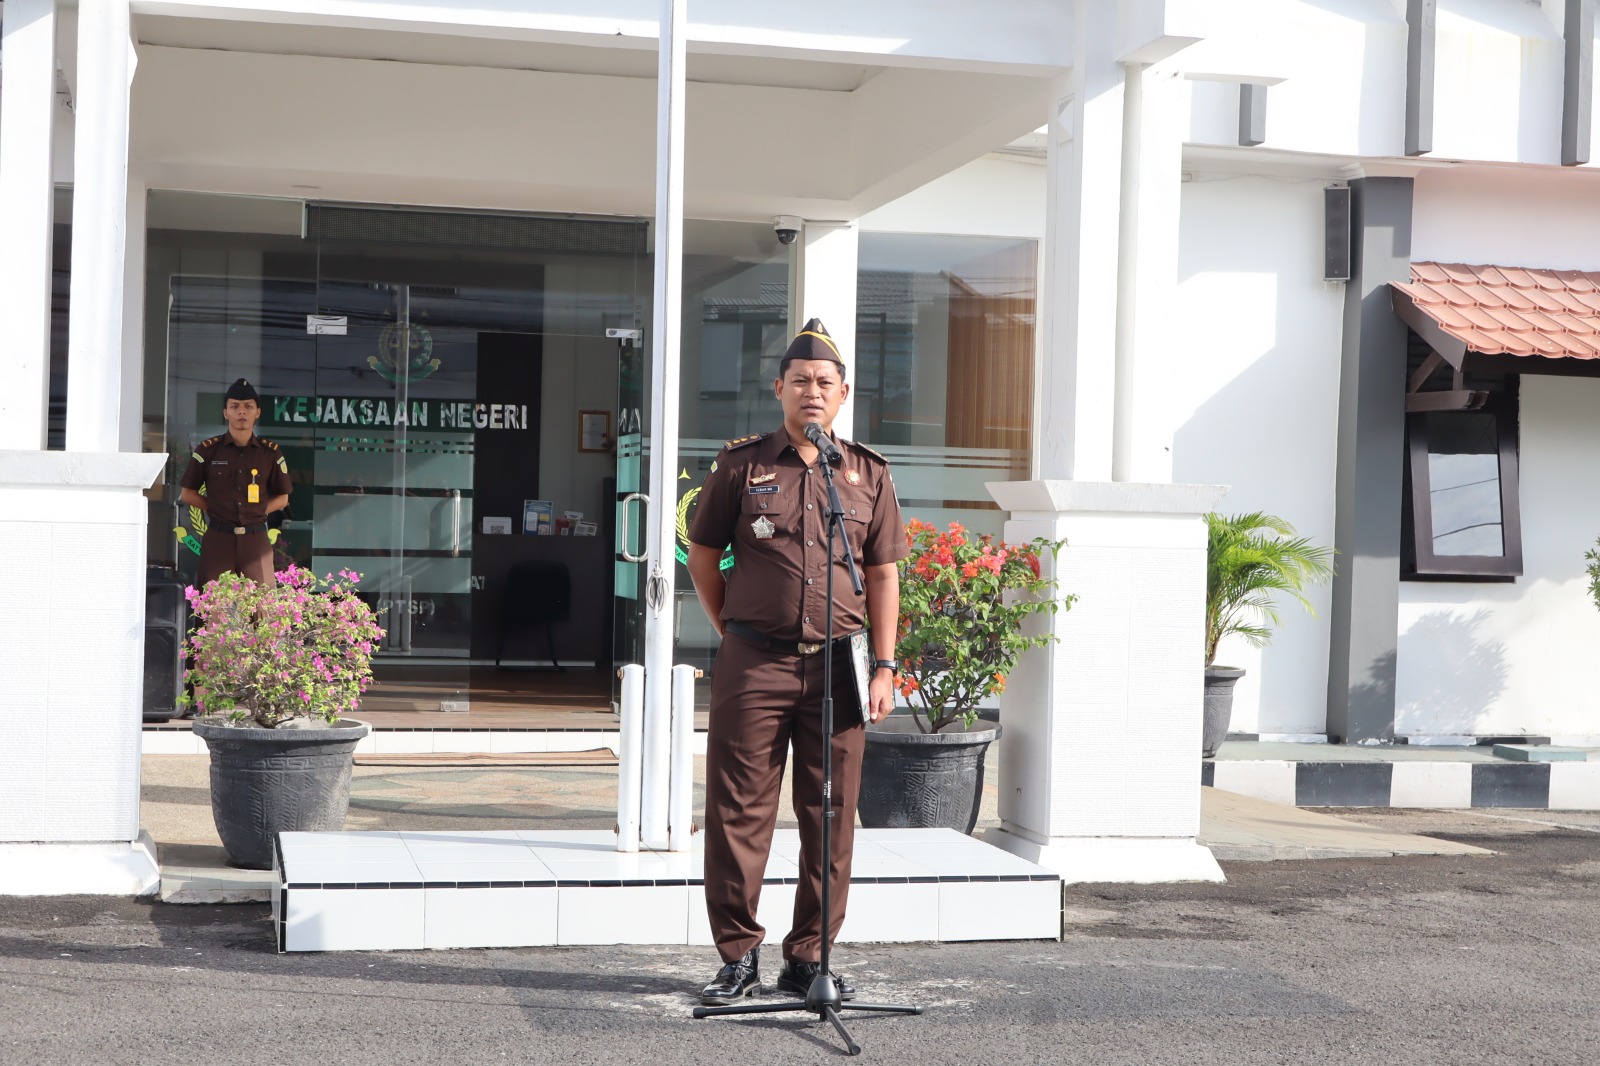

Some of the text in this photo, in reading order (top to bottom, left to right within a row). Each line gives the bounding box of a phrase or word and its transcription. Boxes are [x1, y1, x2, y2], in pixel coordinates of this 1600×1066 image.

[274, 396, 528, 430] KEJAKSAAN NEGERI
[187, 539, 201, 553] SAT
